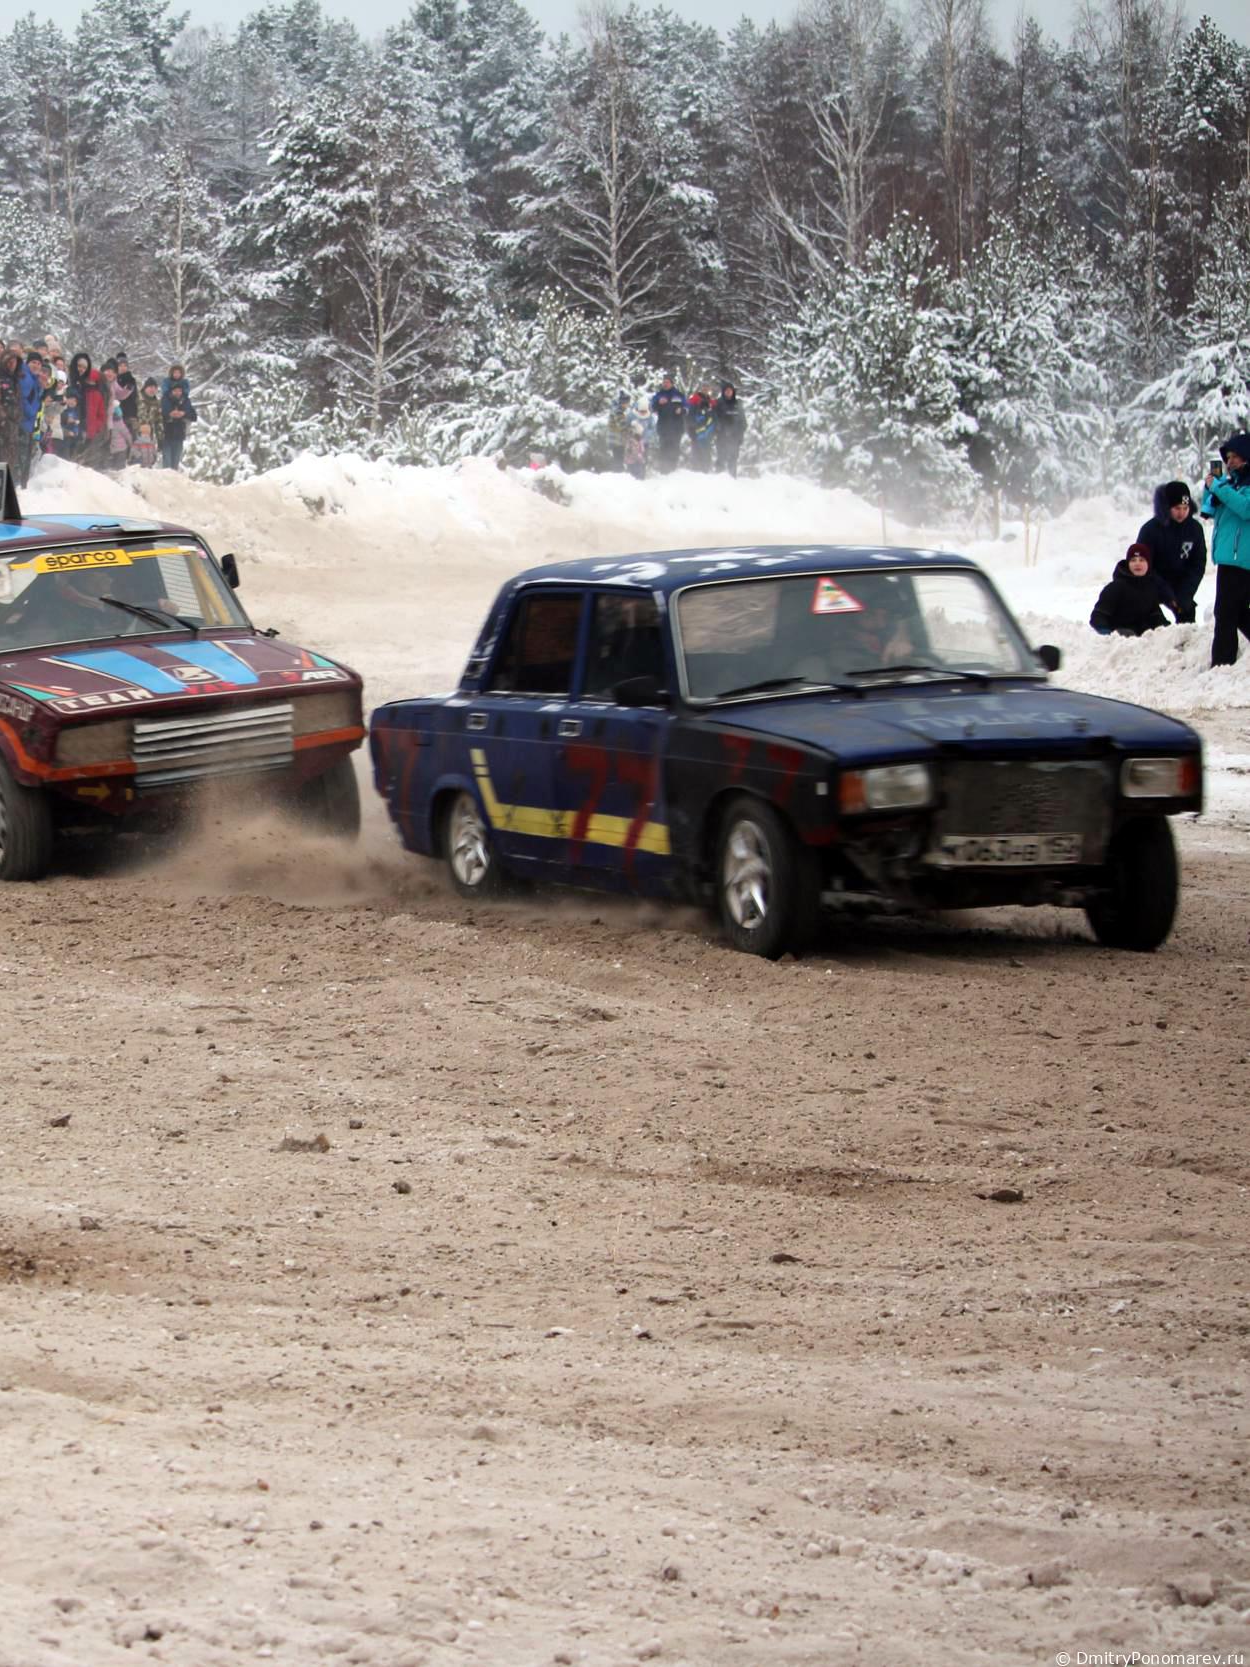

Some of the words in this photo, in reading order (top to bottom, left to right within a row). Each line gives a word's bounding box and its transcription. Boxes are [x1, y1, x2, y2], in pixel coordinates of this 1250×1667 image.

[45, 551, 117, 567] sparco
[57, 688, 154, 709] TEAM
[563, 742, 661, 888] 77
